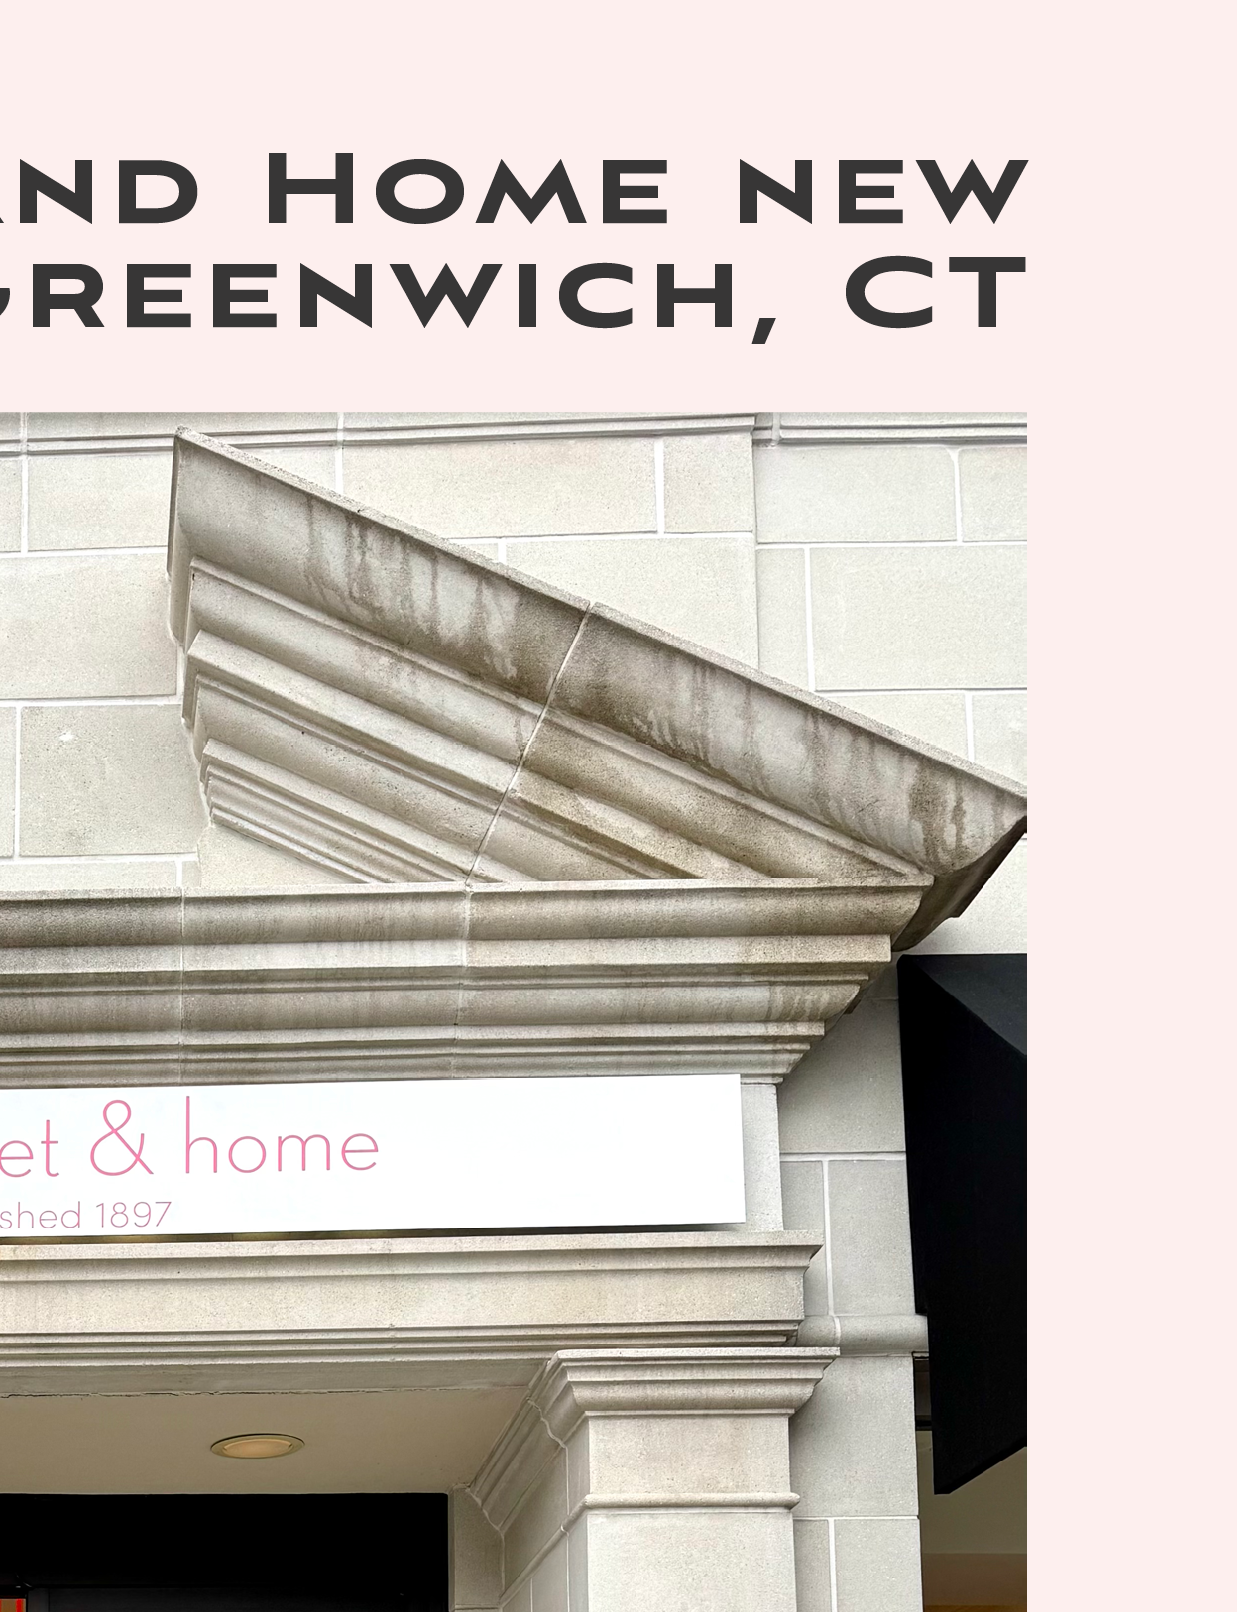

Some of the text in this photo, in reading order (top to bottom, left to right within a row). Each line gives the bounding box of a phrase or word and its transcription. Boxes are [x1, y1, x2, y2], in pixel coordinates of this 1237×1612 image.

[89, 1099, 154, 1177] &
[185, 1096, 379, 1174] home
[96, 1201, 172, 1229] 1897
